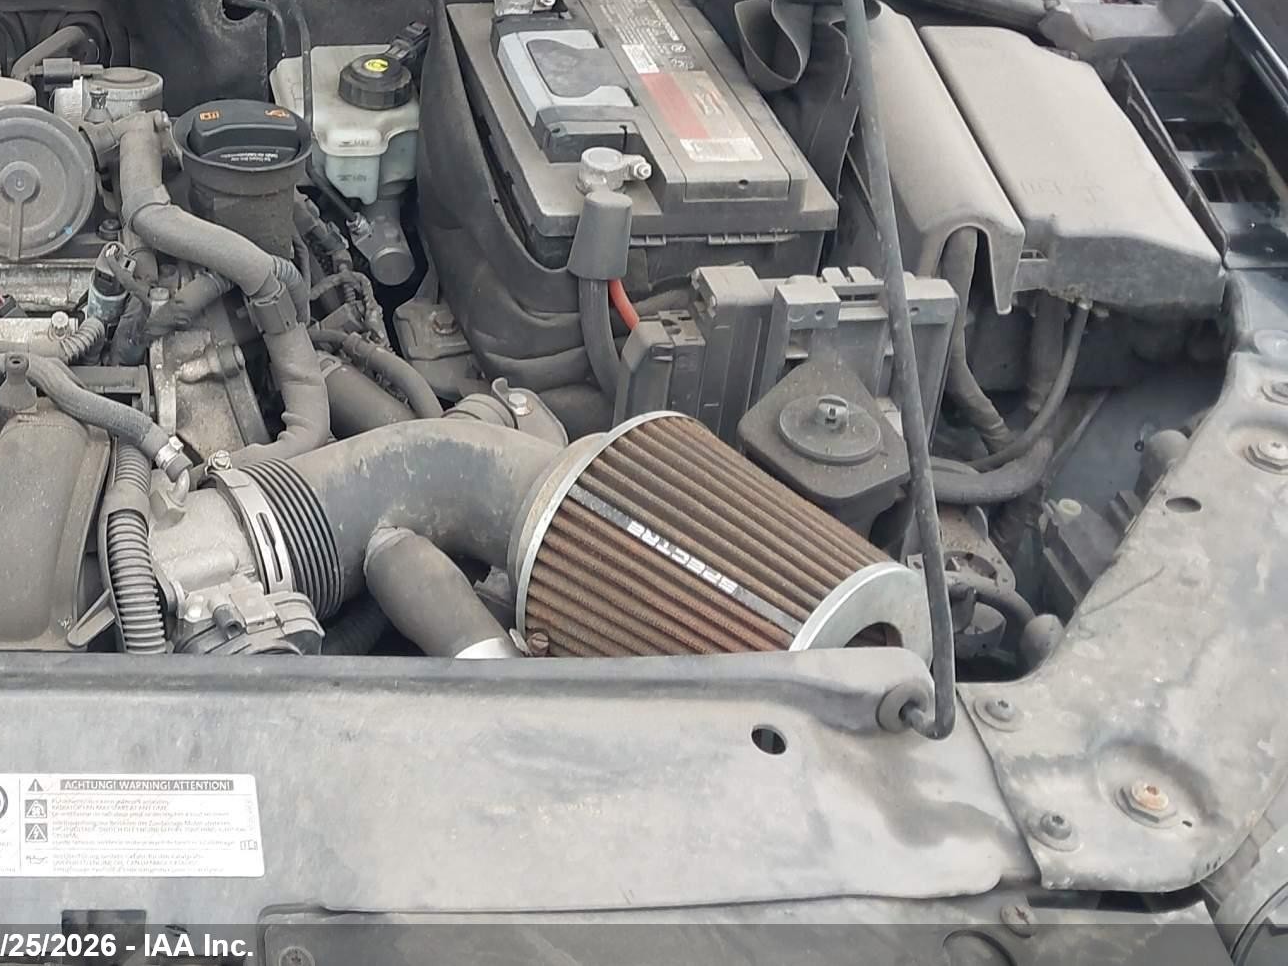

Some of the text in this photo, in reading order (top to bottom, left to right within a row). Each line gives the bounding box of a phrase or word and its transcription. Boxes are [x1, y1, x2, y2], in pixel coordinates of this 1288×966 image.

[626, 520, 738, 595] SPECTRE
[64, 780, 230, 791] ACHTUNG! WARNING! ATTENTION!
